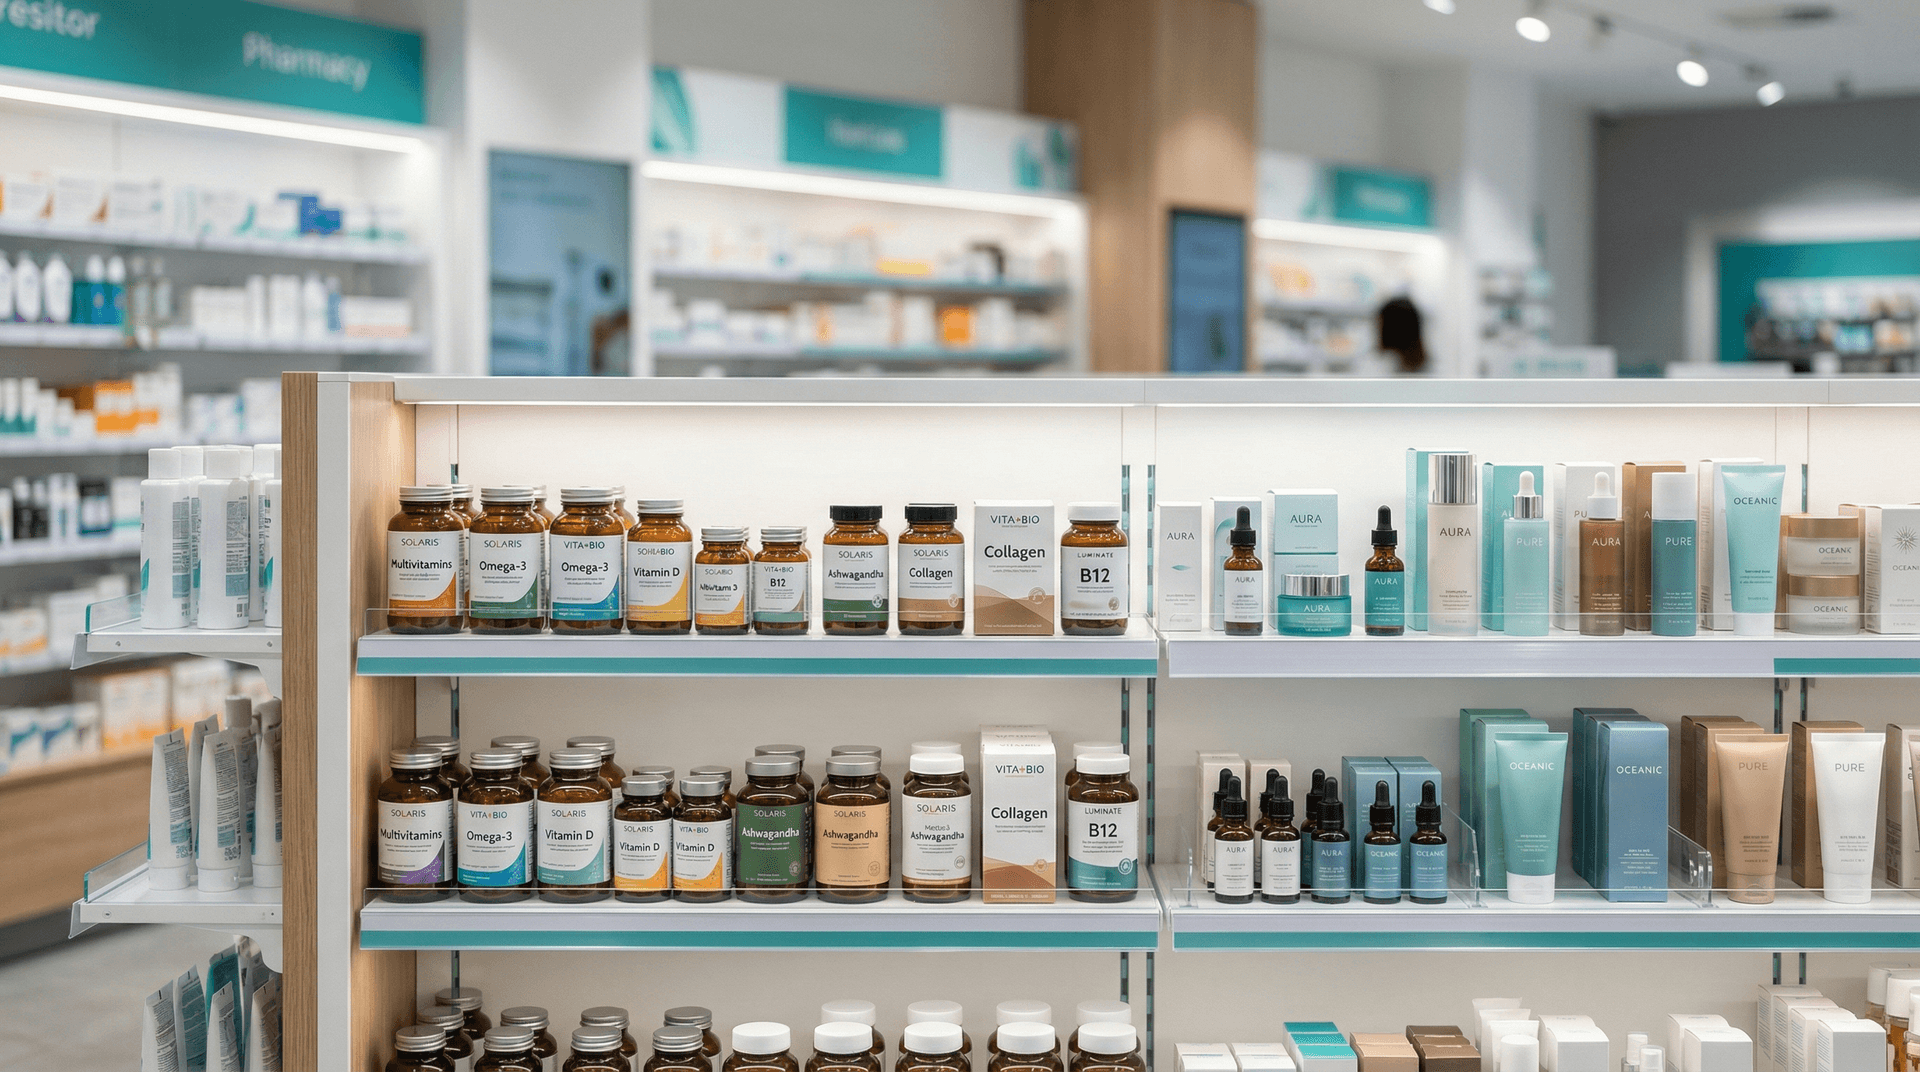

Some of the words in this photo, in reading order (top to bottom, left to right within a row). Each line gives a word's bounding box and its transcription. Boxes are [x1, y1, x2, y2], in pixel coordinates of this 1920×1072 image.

[243, 31, 372, 92] Pharmacy
[1733, 497, 1778, 505] OCEANIC
[1290, 514, 1323, 524] AURA
[1167, 532, 1195, 541] AURA
[1439, 527, 1471, 537] AURA
[401, 538, 439, 547] SOLARIS
[484, 540, 522, 548] SOLARIS
[1516, 537, 1544, 547] PURE
[1592, 537, 1621, 547] AURA
[1665, 537, 1692, 546] PURE
[838, 551, 873, 559] SOLARIS
[913, 549, 949, 557] SOLARIS
[984, 545, 1046, 561] Collagen
[391, 559, 453, 570] Multivitamins
[479, 561, 527, 573] Omega-3
[561, 562, 609, 575] Omega-3
[634, 567, 670, 577] Vitamin
[672, 567, 680, 577] D
[909, 567, 953, 580] Collagen
[1080, 568, 1110, 583] B12
[770, 578, 786, 587] B12
[1304, 604, 1331, 613] AURA
[1509, 762, 1555, 771] OCEANIC
[1616, 766, 1663, 775] OCEANIC
[1738, 762, 1768, 771] PURE
[1835, 763, 1865, 772] PURE
[391, 809, 426, 818] SOLARIS
[551, 809, 587, 818] SOLARIS
[916, 804, 956, 813] SOLARIS
[1085, 807, 1122, 815] LUMINATE
[834, 810, 866, 818] SOLARIS
[991, 807, 1048, 822] Collagen
[624, 825, 654, 833] SOLARIS
[742, 827, 800, 840] Ashwagandha
[1089, 823, 1118, 838] B12
[380, 828, 443, 841] Multivitamins
[466, 830, 513, 844] Omega-3
[545, 829, 583, 841] Vitamin
[586, 829, 594, 840] D
[822, 829, 879, 842] Ashwagandha
[910, 831, 965, 842] Ashwagandha
[619, 842, 651, 852] Vitamin
[653, 842, 660, 851] D
[675, 842, 706, 852] Vitamin
[708, 843, 715, 852] D
